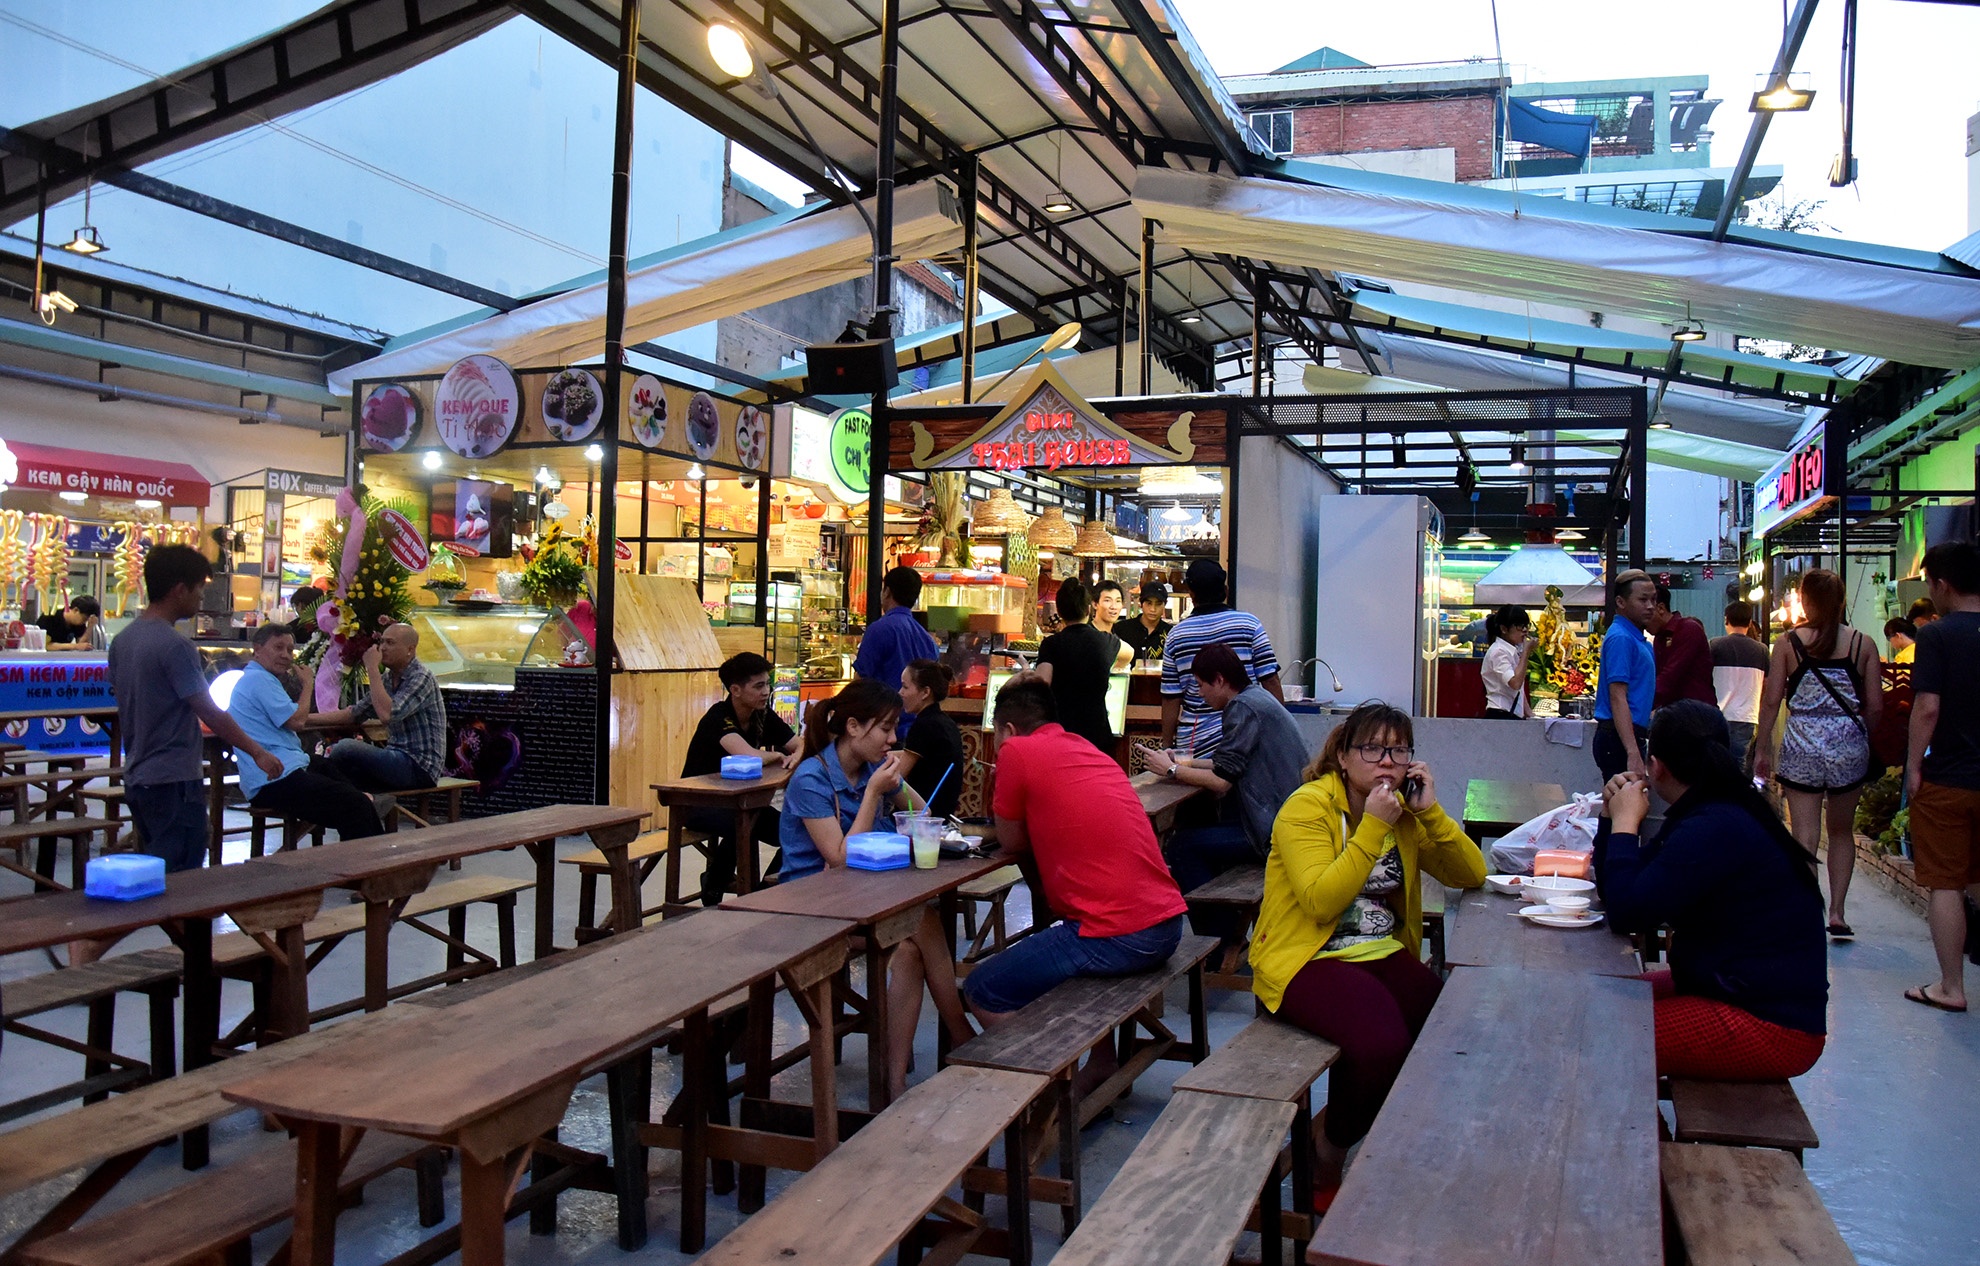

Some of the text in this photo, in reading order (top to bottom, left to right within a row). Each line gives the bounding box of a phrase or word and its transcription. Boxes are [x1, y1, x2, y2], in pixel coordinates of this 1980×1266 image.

[442, 398, 510, 415] KEM QUE
[441, 416, 458, 438] Ti
[844, 416, 872, 437] FAST FO
[1025, 411, 1075, 433] MINI
[972, 439, 1132, 472] THAI HOUSE
[28, 469, 175, 498] KEM GẬY HÀN QUỐC
[268, 471, 302, 492] BOX
[325, 484, 344, 496] SMOOT
[1798, 445, 1822, 501] TÈO
[30, 667, 67, 683] KEM
[27, 687, 52, 698] KEM
[56, 684, 80, 700] GẬY
[83, 683, 105, 697] HÀN
